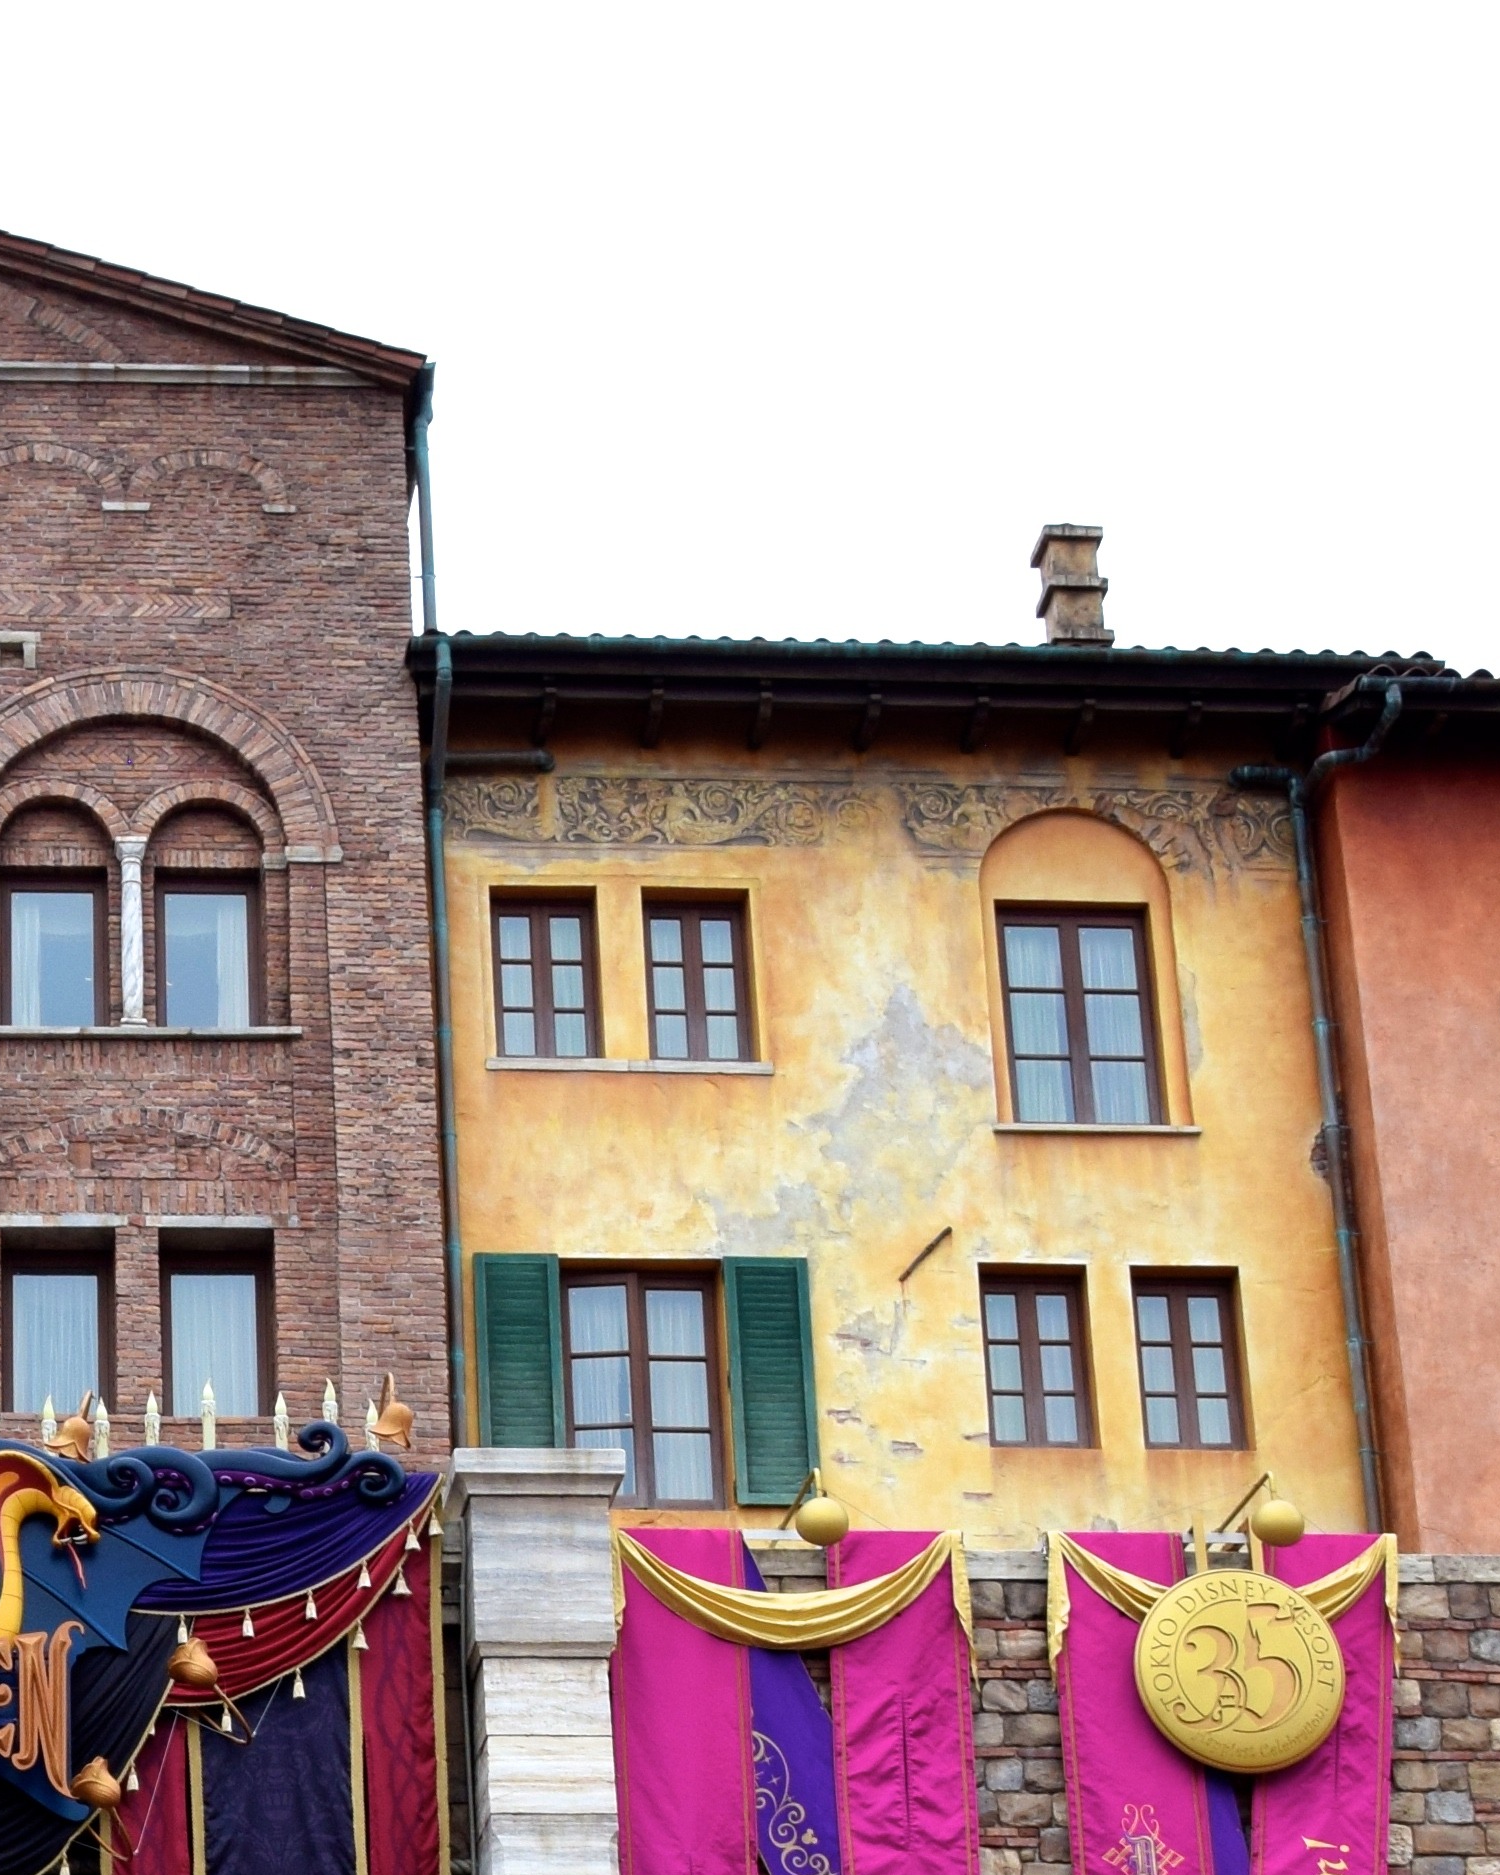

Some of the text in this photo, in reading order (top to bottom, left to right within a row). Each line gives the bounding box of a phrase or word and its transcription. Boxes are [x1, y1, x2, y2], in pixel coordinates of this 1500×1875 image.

[1150, 1578, 1336, 1713] TOKYO DISNEY RESORT
[1172, 1602, 1306, 1734] 35
